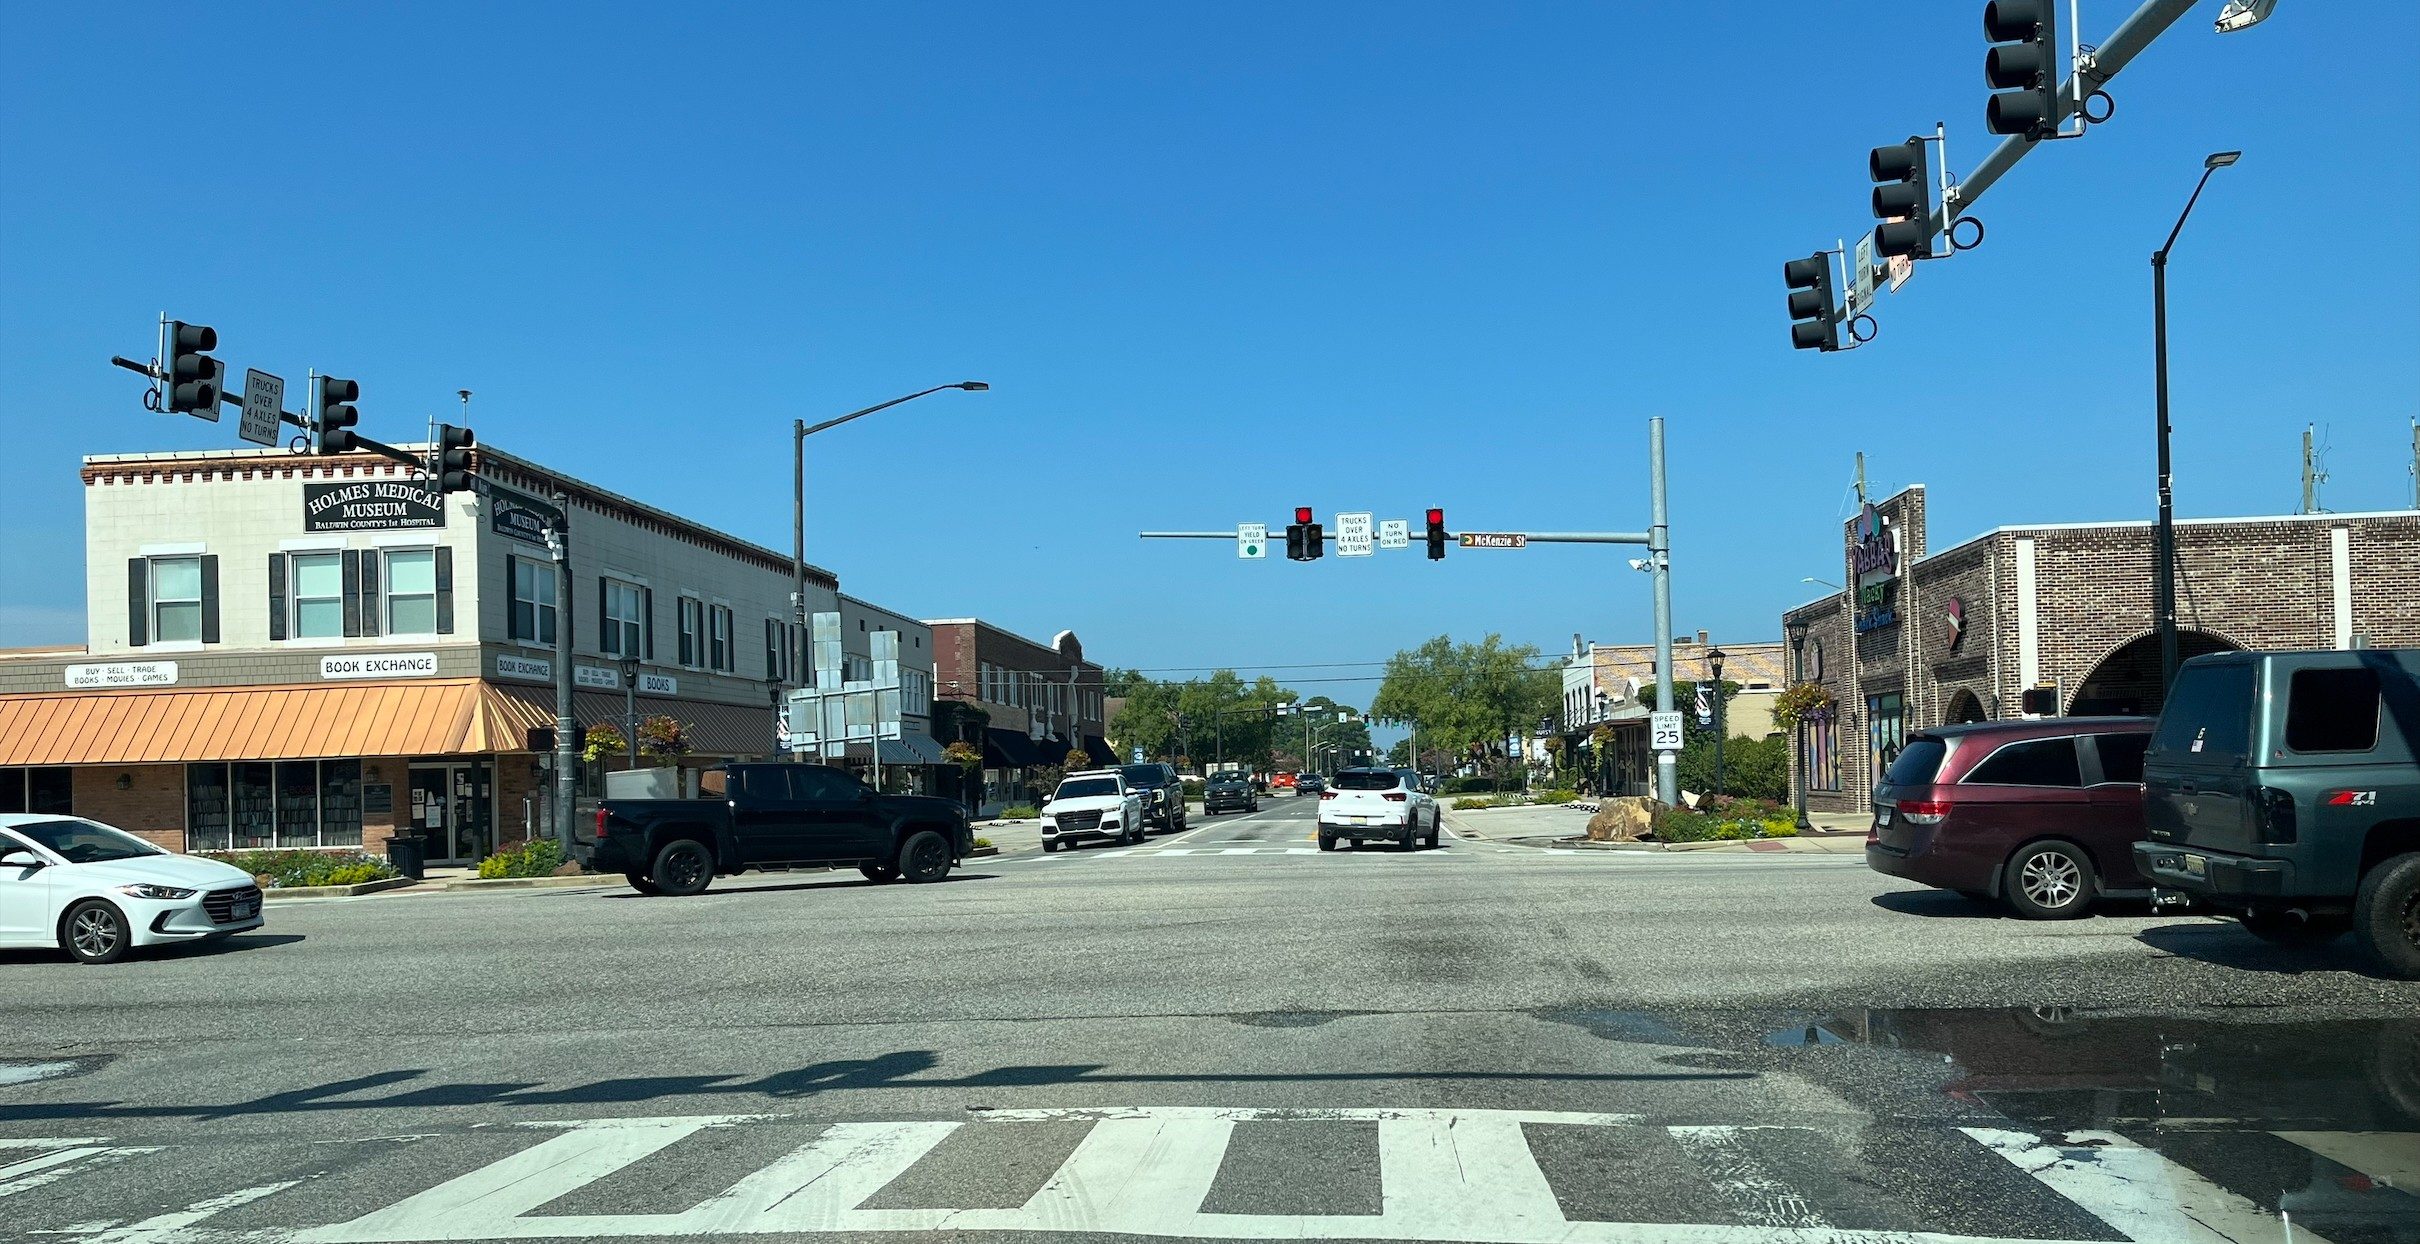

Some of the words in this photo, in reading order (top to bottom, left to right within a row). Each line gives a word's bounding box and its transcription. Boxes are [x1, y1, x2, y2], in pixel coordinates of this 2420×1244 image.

[252, 377, 279, 395] TRUCKS
[255, 393, 273, 408] OVER
[247, 407, 252, 417] 4
[254, 410, 276, 425] AXLES
[241, 422, 252, 433] NO
[254, 424, 277, 439] TURNS
[308, 484, 369, 516] HOLMES
[375, 483, 442, 511] MEDICAL
[343, 502, 408, 518] MUSEUM
[315, 521, 349, 530] BALDWIN
[350, 519, 387, 529] COUNTY'S
[401, 518, 436, 527] HOSPITAL
[510, 512, 541, 533] MUSEUM
[1342, 516, 1367, 524] TRUCKS
[1346, 526, 1363, 534] OVER
[1347, 535, 1369, 543] AXLES
[1474, 535, 1512, 546] McKenzie
[1515, 535, 1525, 546] St
[1350, 544, 1371, 552] TURNS
[85, 667, 100, 675] BUY
[132, 665, 156, 673] TRADE
[326, 660, 360, 673] BOOK
[366, 658, 432, 672] EXCHANGE
[499, 659, 516, 673] BOOK
[518, 662, 548, 676] EXCHANGE
[74, 677, 99, 685] BOOKS
[107, 675, 135, 683] MOVIES
[142, 673, 168, 682] GAMES
[647, 676, 670, 691] BOOKS
[1656, 730, 1679, 744] 25
